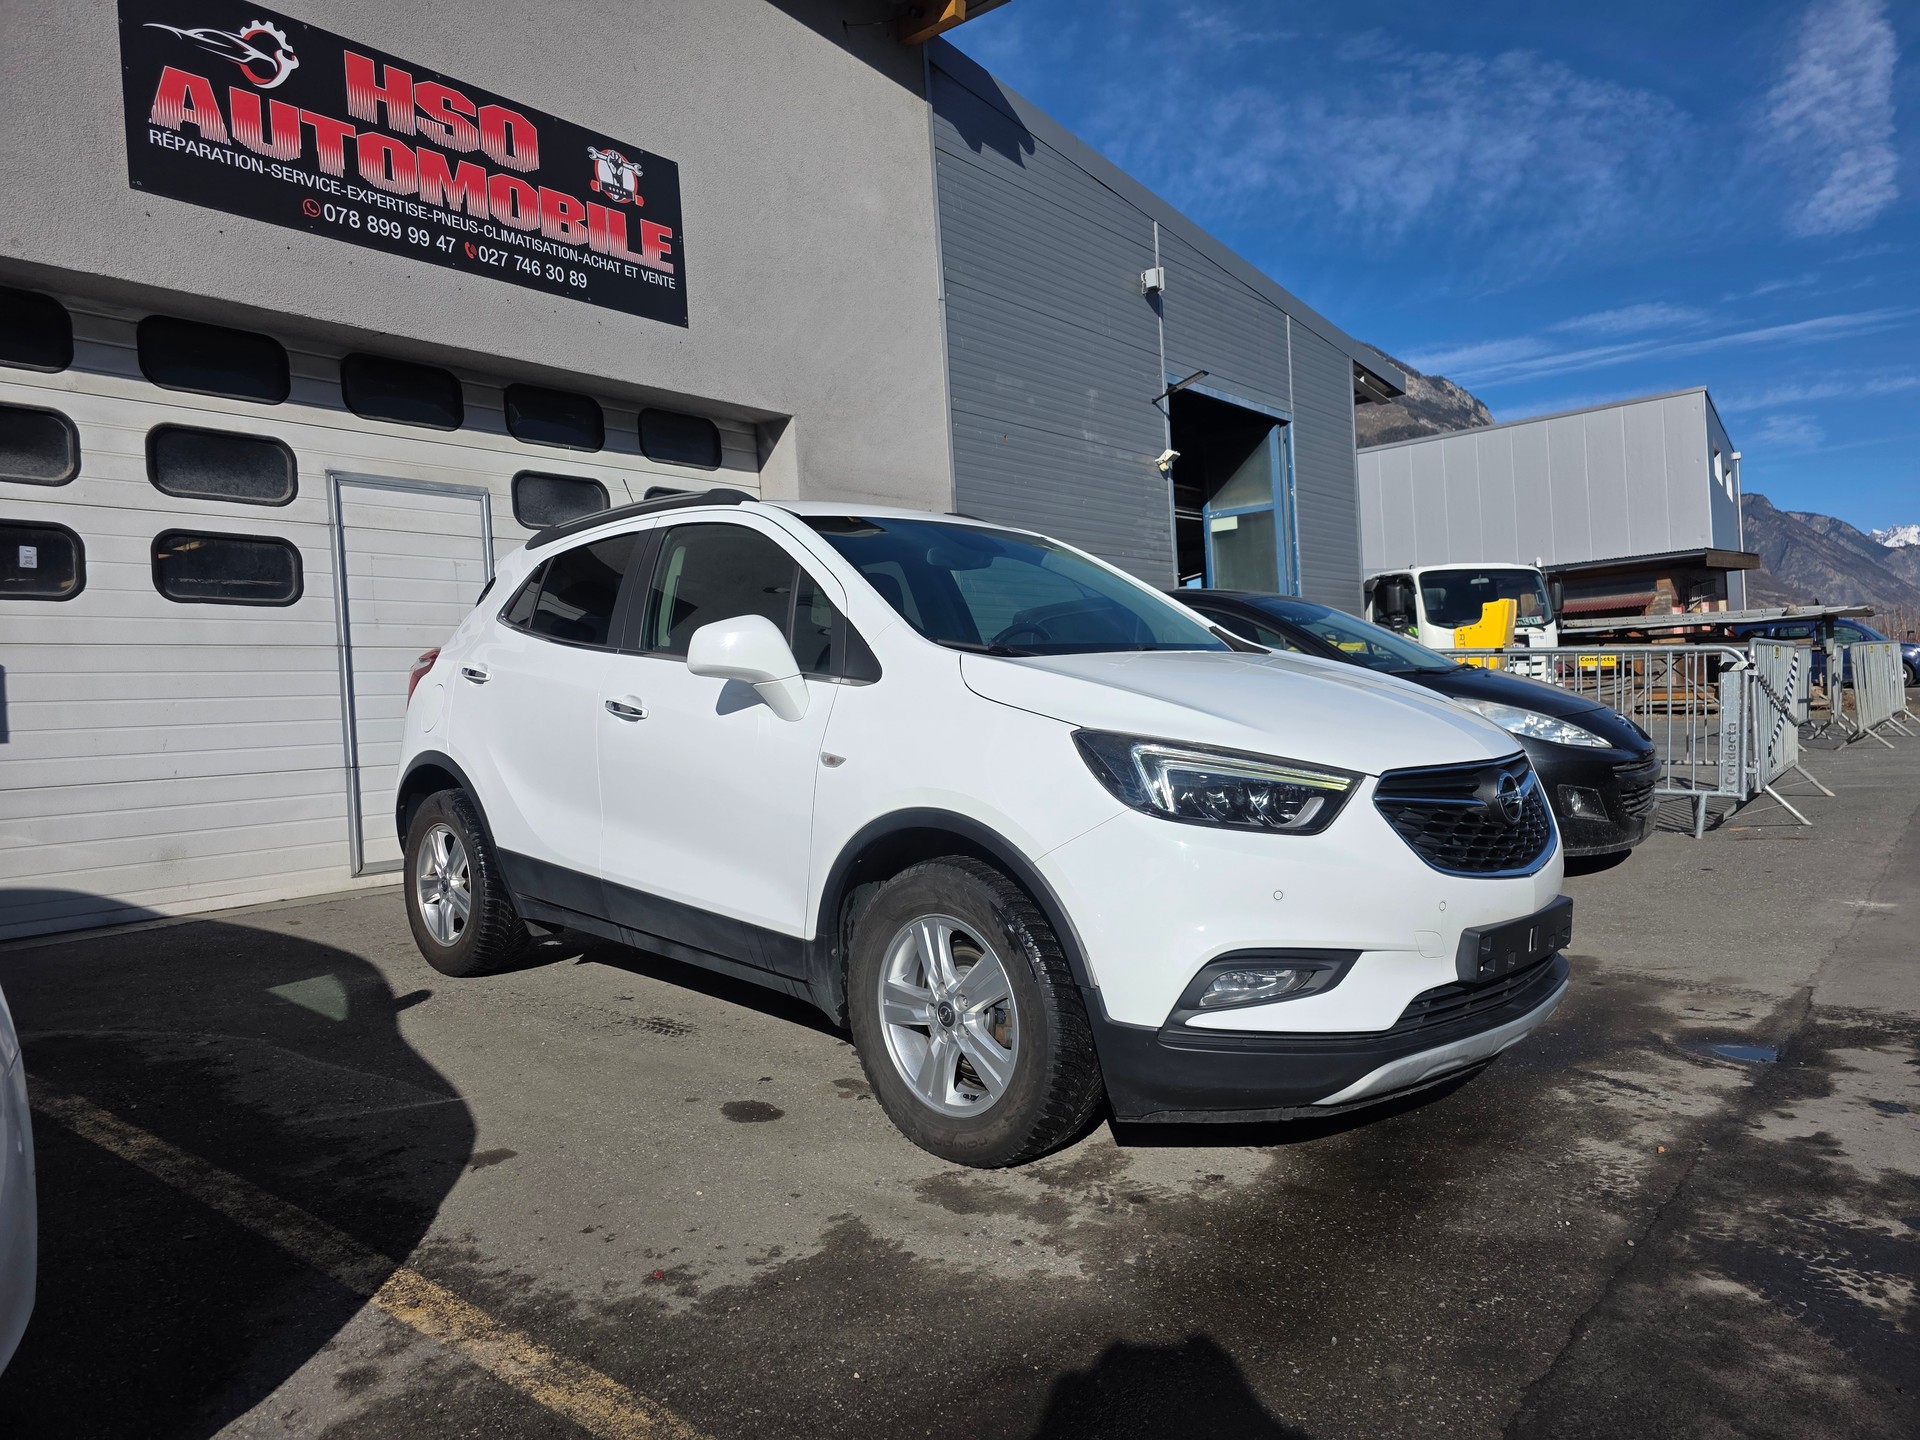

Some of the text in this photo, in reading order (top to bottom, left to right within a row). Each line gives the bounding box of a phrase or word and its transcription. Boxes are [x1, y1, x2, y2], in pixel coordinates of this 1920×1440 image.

[344, 50, 539, 173] HSO
[148, 66, 674, 274] AUTOMOBILE
[323, 203, 456, 254] 078 899 99 47
[478, 245, 588, 289] 027 746 30 89
[624, 265, 639, 279] ET
[641, 268, 676, 290] VENTE
